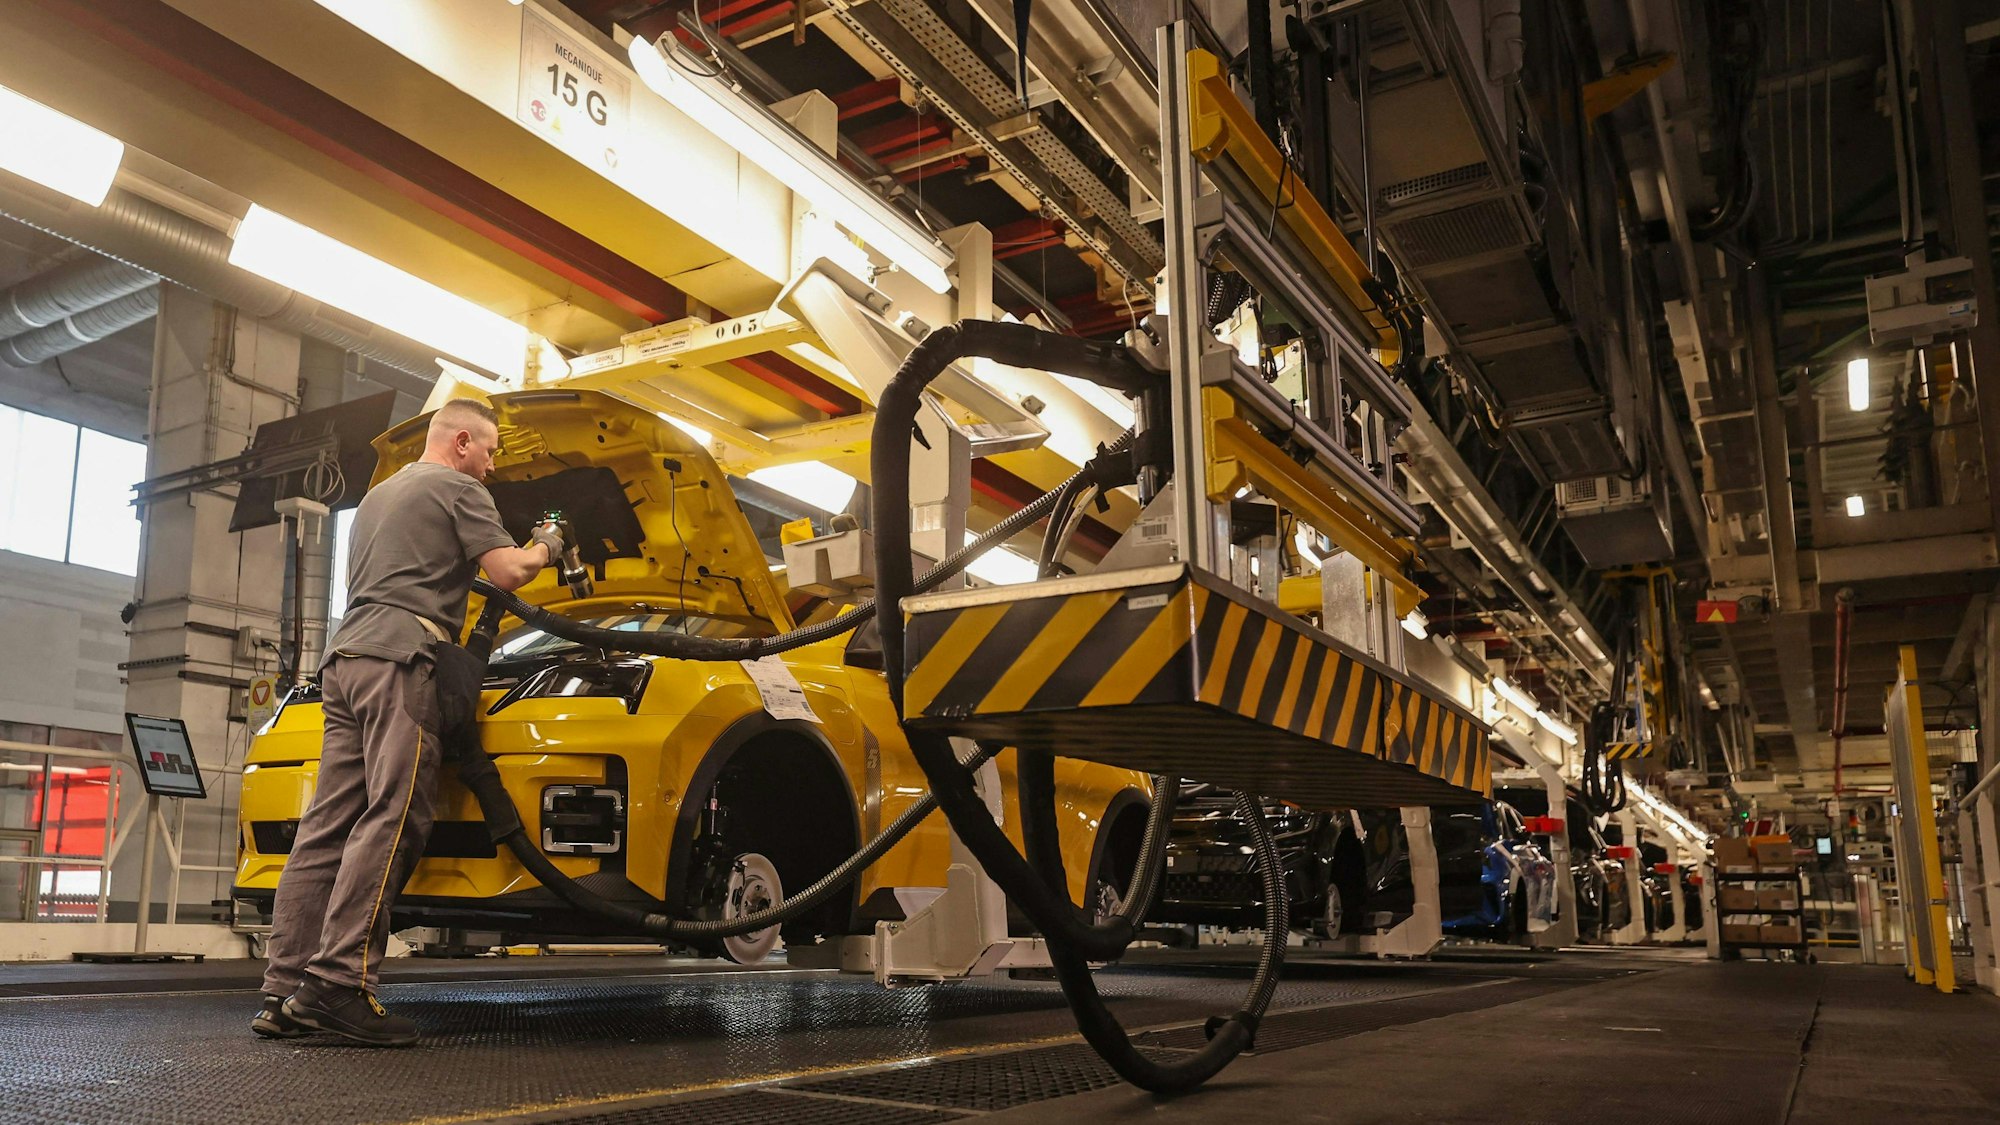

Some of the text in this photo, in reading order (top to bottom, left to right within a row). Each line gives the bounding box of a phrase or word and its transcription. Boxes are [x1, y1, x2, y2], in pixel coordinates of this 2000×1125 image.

[555, 43, 603, 84] MECANIQUE
[547, 63, 608, 126] 15 G
